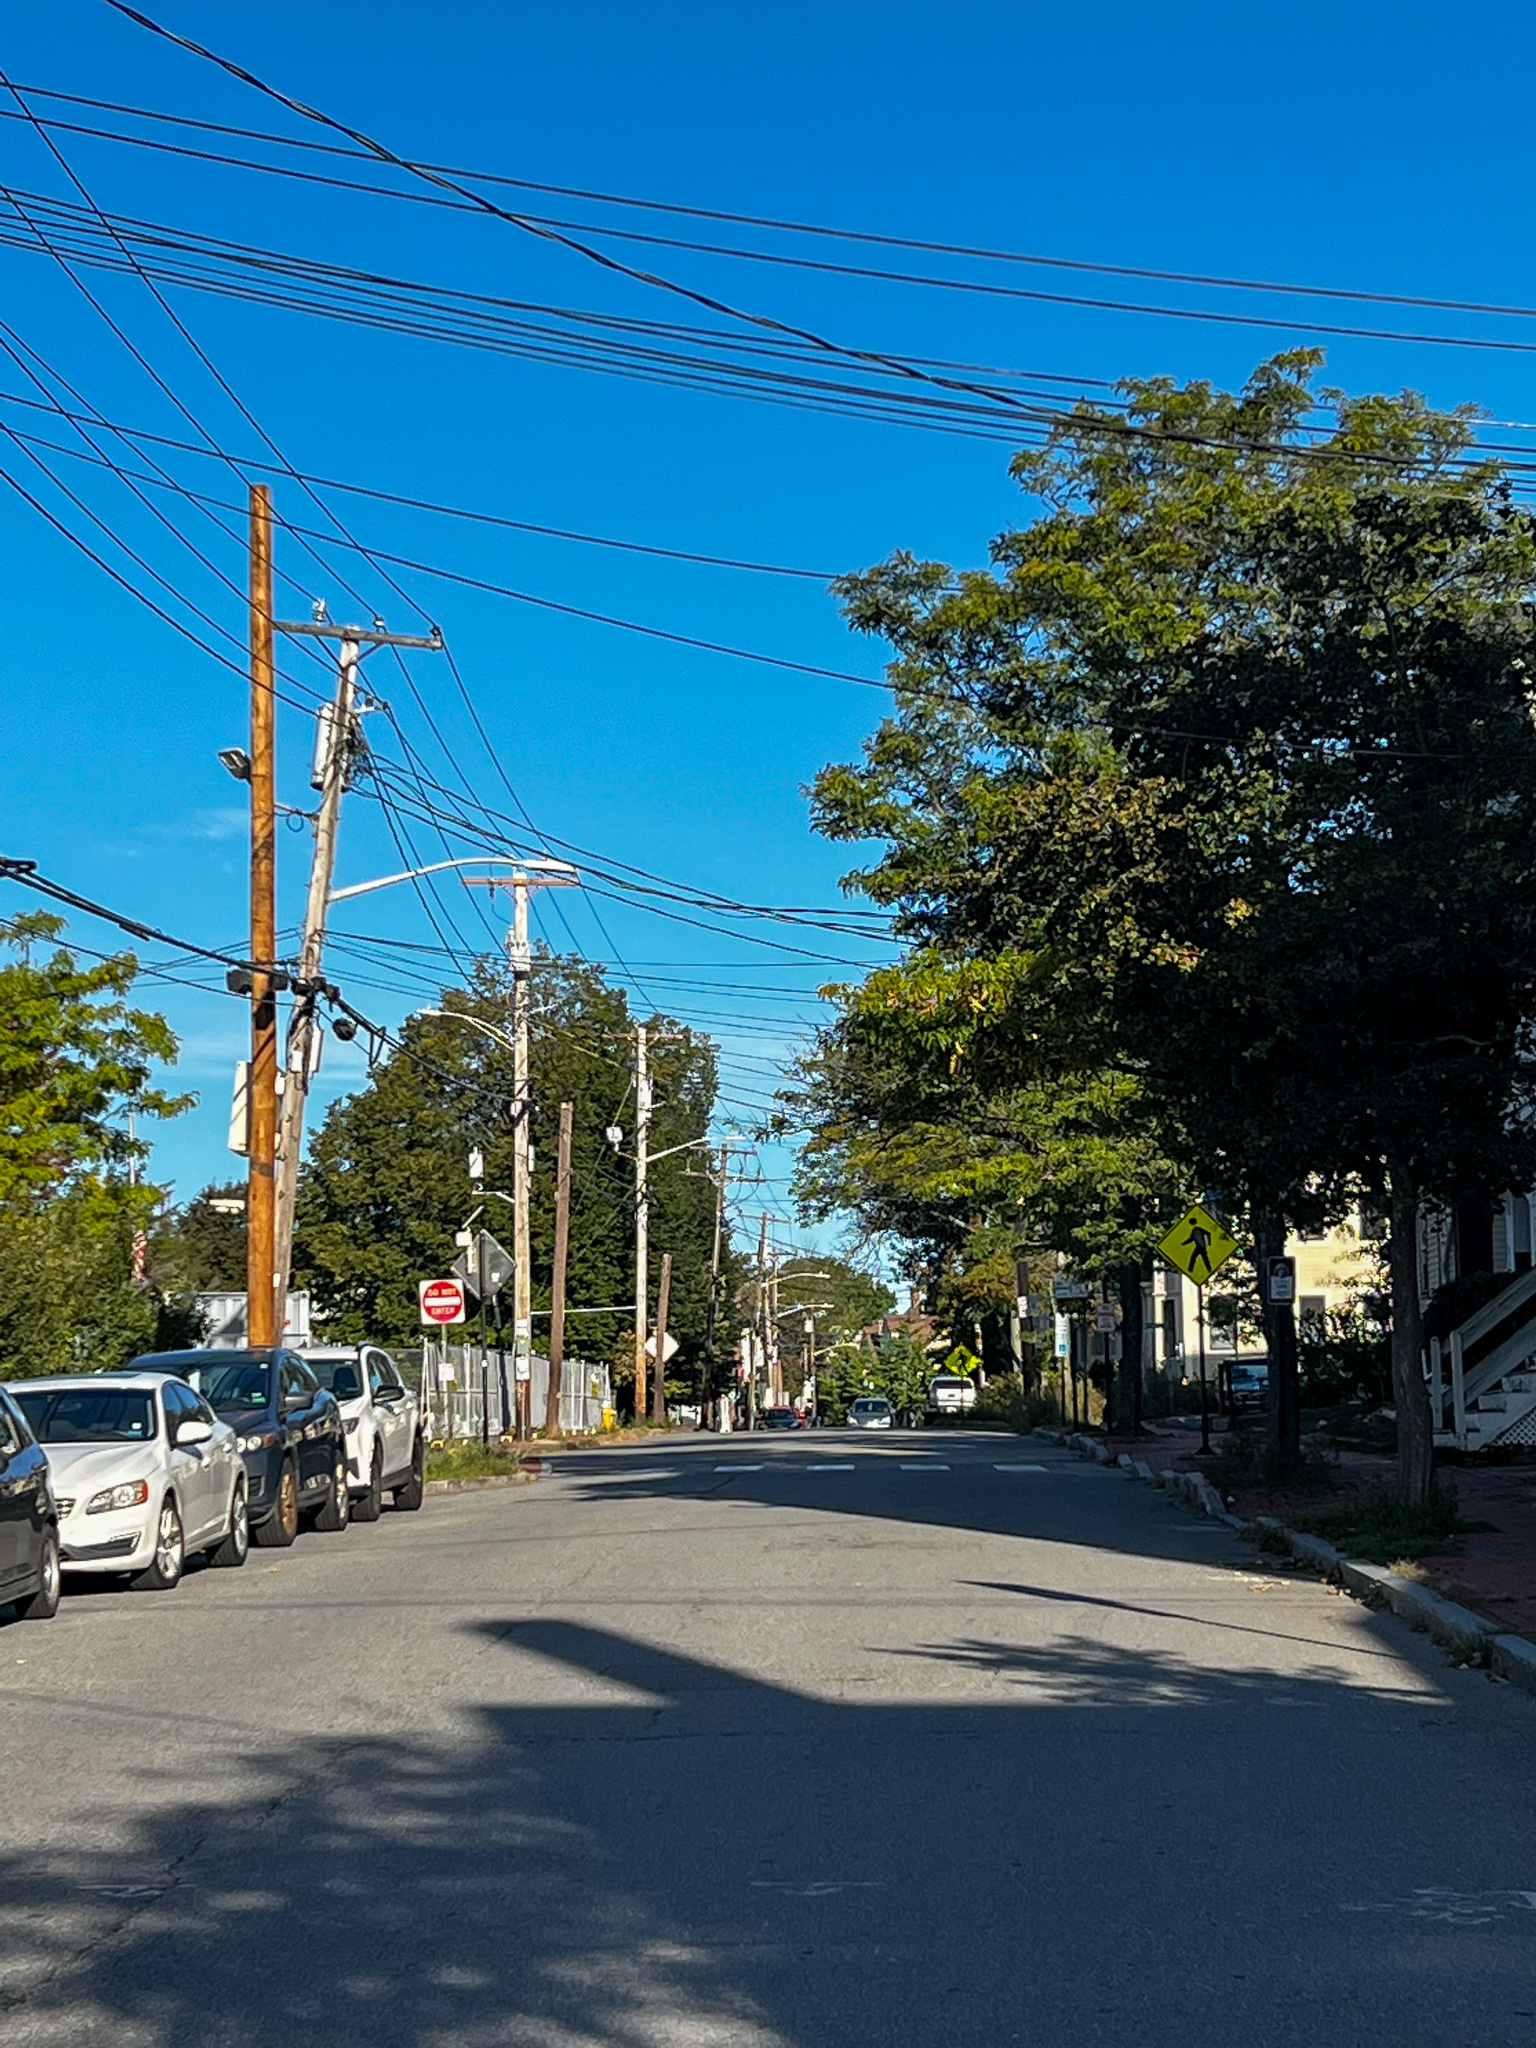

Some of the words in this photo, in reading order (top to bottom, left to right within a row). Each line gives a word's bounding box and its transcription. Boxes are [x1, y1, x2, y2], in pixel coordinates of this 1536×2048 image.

[427, 1288, 439, 1297] DO
[441, 1287, 456, 1296] NOT
[431, 1307, 455, 1315] ENTER
